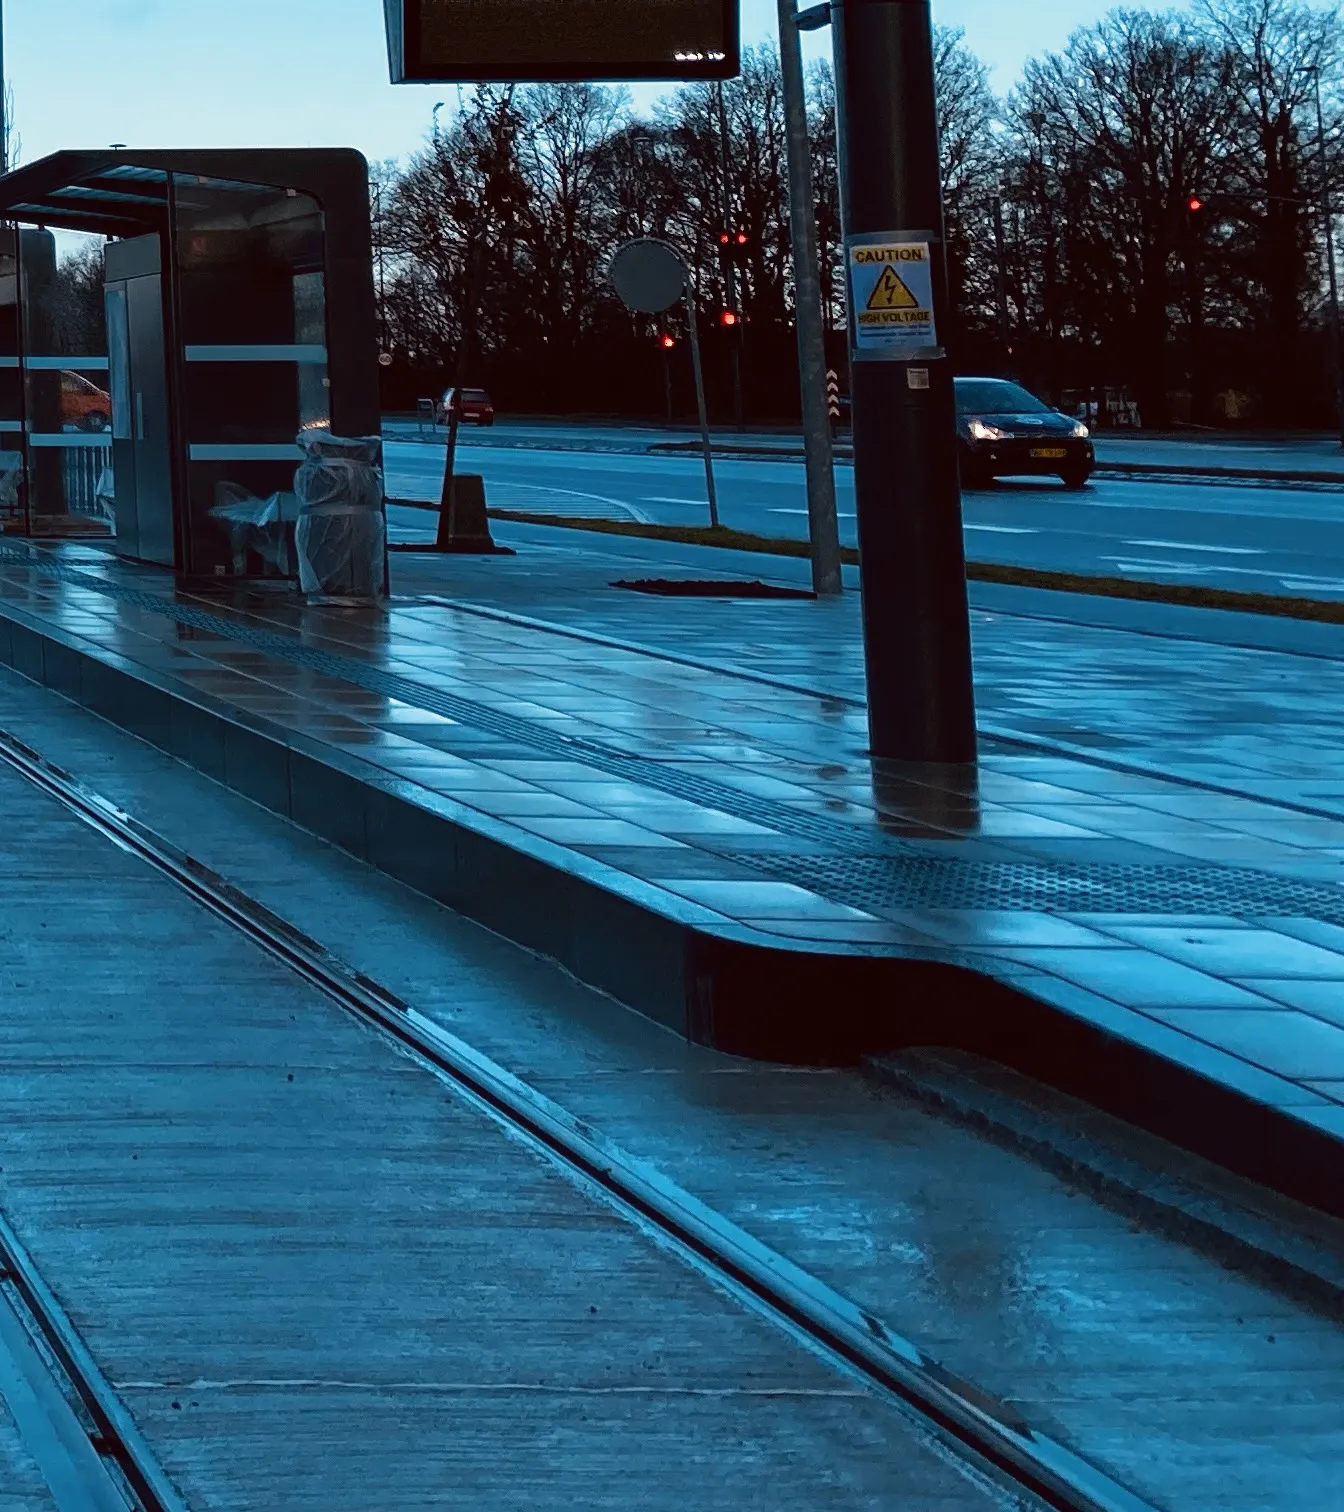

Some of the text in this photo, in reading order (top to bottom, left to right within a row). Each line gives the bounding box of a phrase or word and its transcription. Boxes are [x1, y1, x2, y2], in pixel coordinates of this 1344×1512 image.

[855, 248, 923, 263] CAUTION
[858, 311, 930, 324] HIGH VOLTAGE
